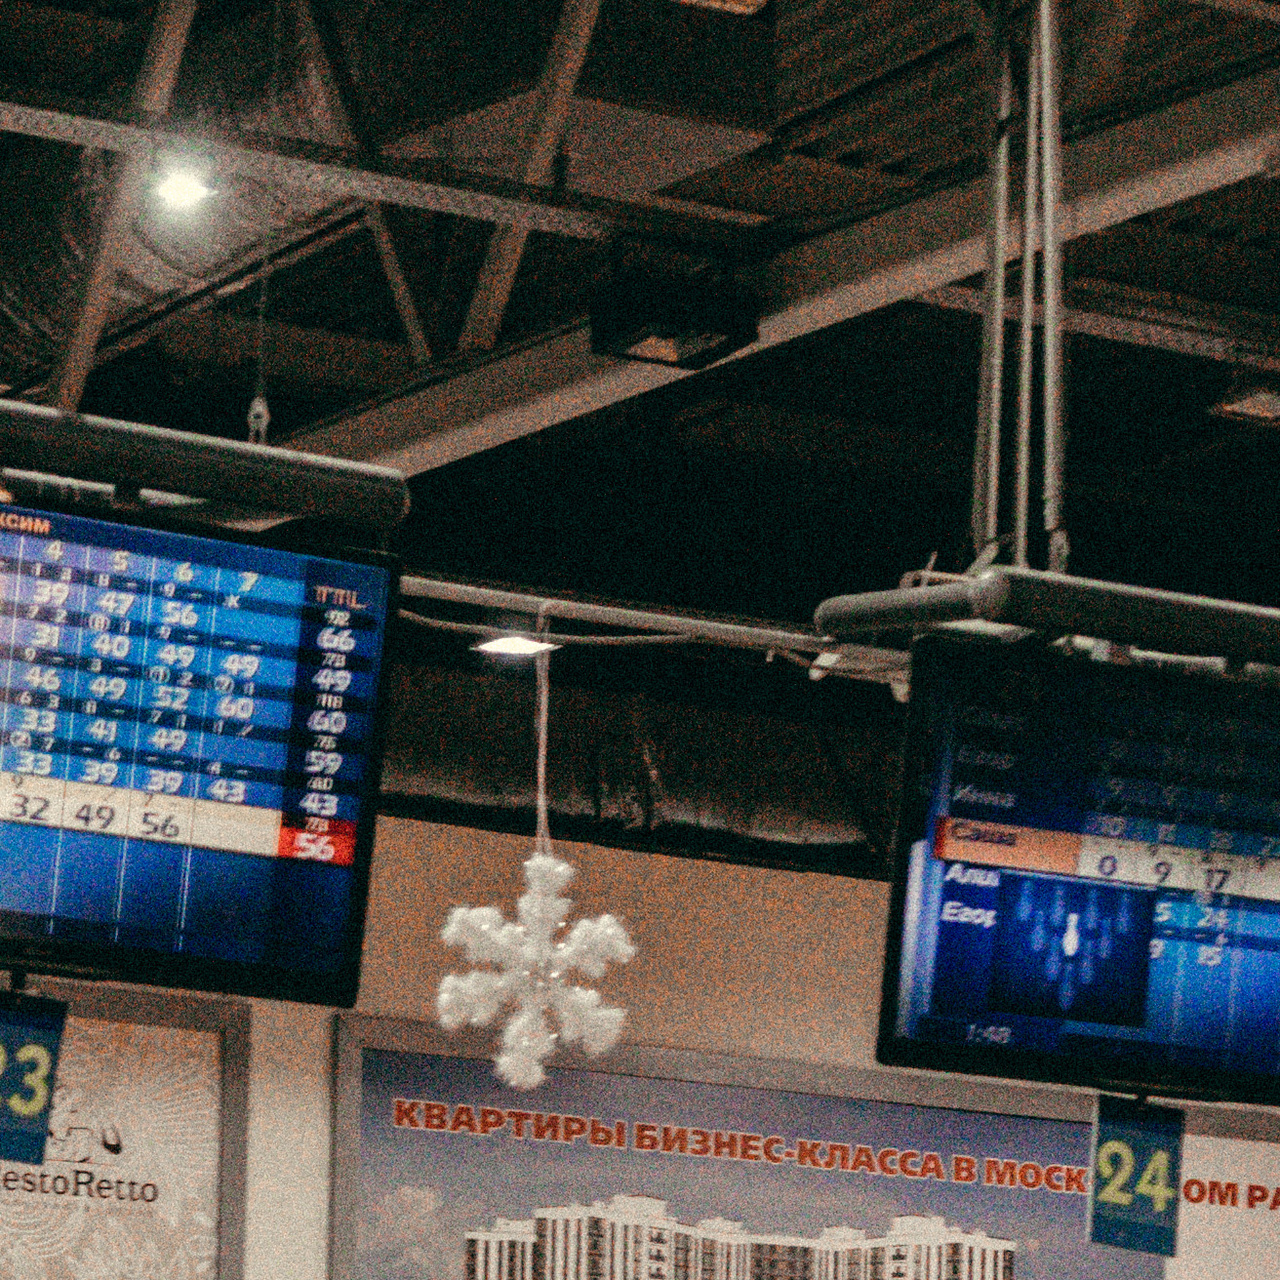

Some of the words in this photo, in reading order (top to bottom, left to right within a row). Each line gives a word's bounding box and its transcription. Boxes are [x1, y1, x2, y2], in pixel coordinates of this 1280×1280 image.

[46, 540, 63, 561] 4
[112, 550, 129, 572] 5
[174, 562, 194, 582] 6
[239, 572, 259, 592] 7
[33, 580, 70, 605] 39
[97, 591, 134, 616] 47
[163, 601, 199, 628] 56
[317, 627, 356, 652] 66
[32, 623, 60, 648] 31
[94, 635, 131, 659] 40
[157, 644, 195, 668] 49
[223, 653, 259, 679] 49
[311, 668, 352, 693] 49
[28, 665, 61, 691] 46
[90, 675, 127, 701] 49
[153, 684, 191, 712] 52
[216, 696, 254, 719] 60
[306, 710, 348, 735] 60
[22, 708, 57, 733] 33
[88, 718, 117, 743] 41
[151, 728, 187, 752] 49
[304, 750, 344, 775] 59
[17, 751, 52, 775] 33
[83, 760, 119, 784] 39
[147, 770, 184, 793] 39
[207, 778, 246, 803] 43
[299, 792, 340, 817] 43
[12, 793, 50, 821] 32
[75, 803, 116, 830] 49
[141, 812, 180, 839] 56
[293, 832, 335, 862] 56
[392, 1098, 627, 1148] КВАРТИРЫ
[634, 1121, 946, 1182] БИЗНЕС-КЛАССА
[952, 1154, 976, 1183] В
[984, 1158, 1089, 1195] МОСК
[1097, 1140, 1178, 1213] 24
[1182, 1178, 1239, 1207] ОМ
